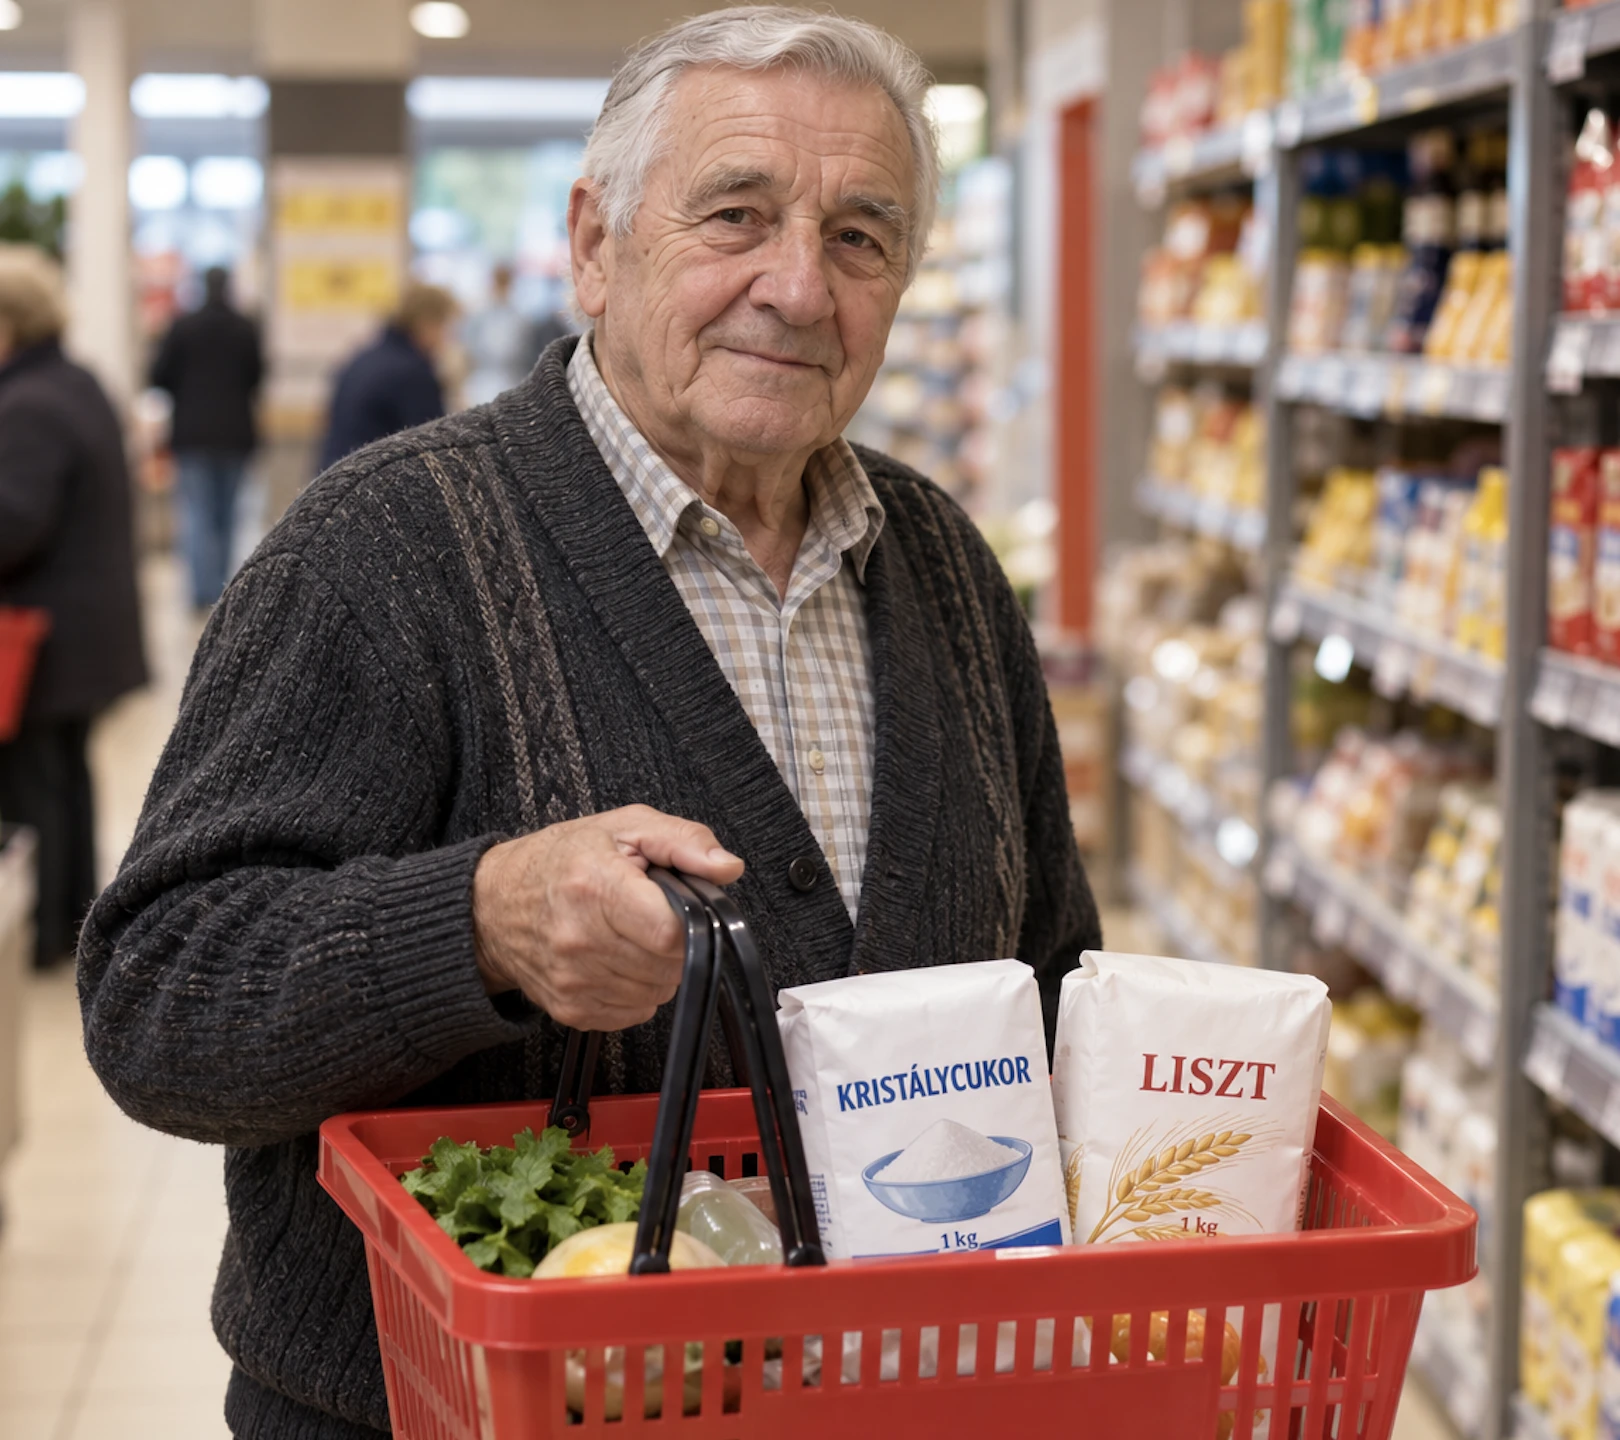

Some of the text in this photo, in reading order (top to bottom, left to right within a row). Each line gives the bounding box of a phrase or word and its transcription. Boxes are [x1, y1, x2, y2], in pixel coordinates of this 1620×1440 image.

[837, 1056, 1032, 1112] KRISTÁLYCUKOR
[1139, 1053, 1277, 1101] LISZT
[941, 1231, 978, 1250] 1 kg
[1181, 1216, 1219, 1237] 1 kg
